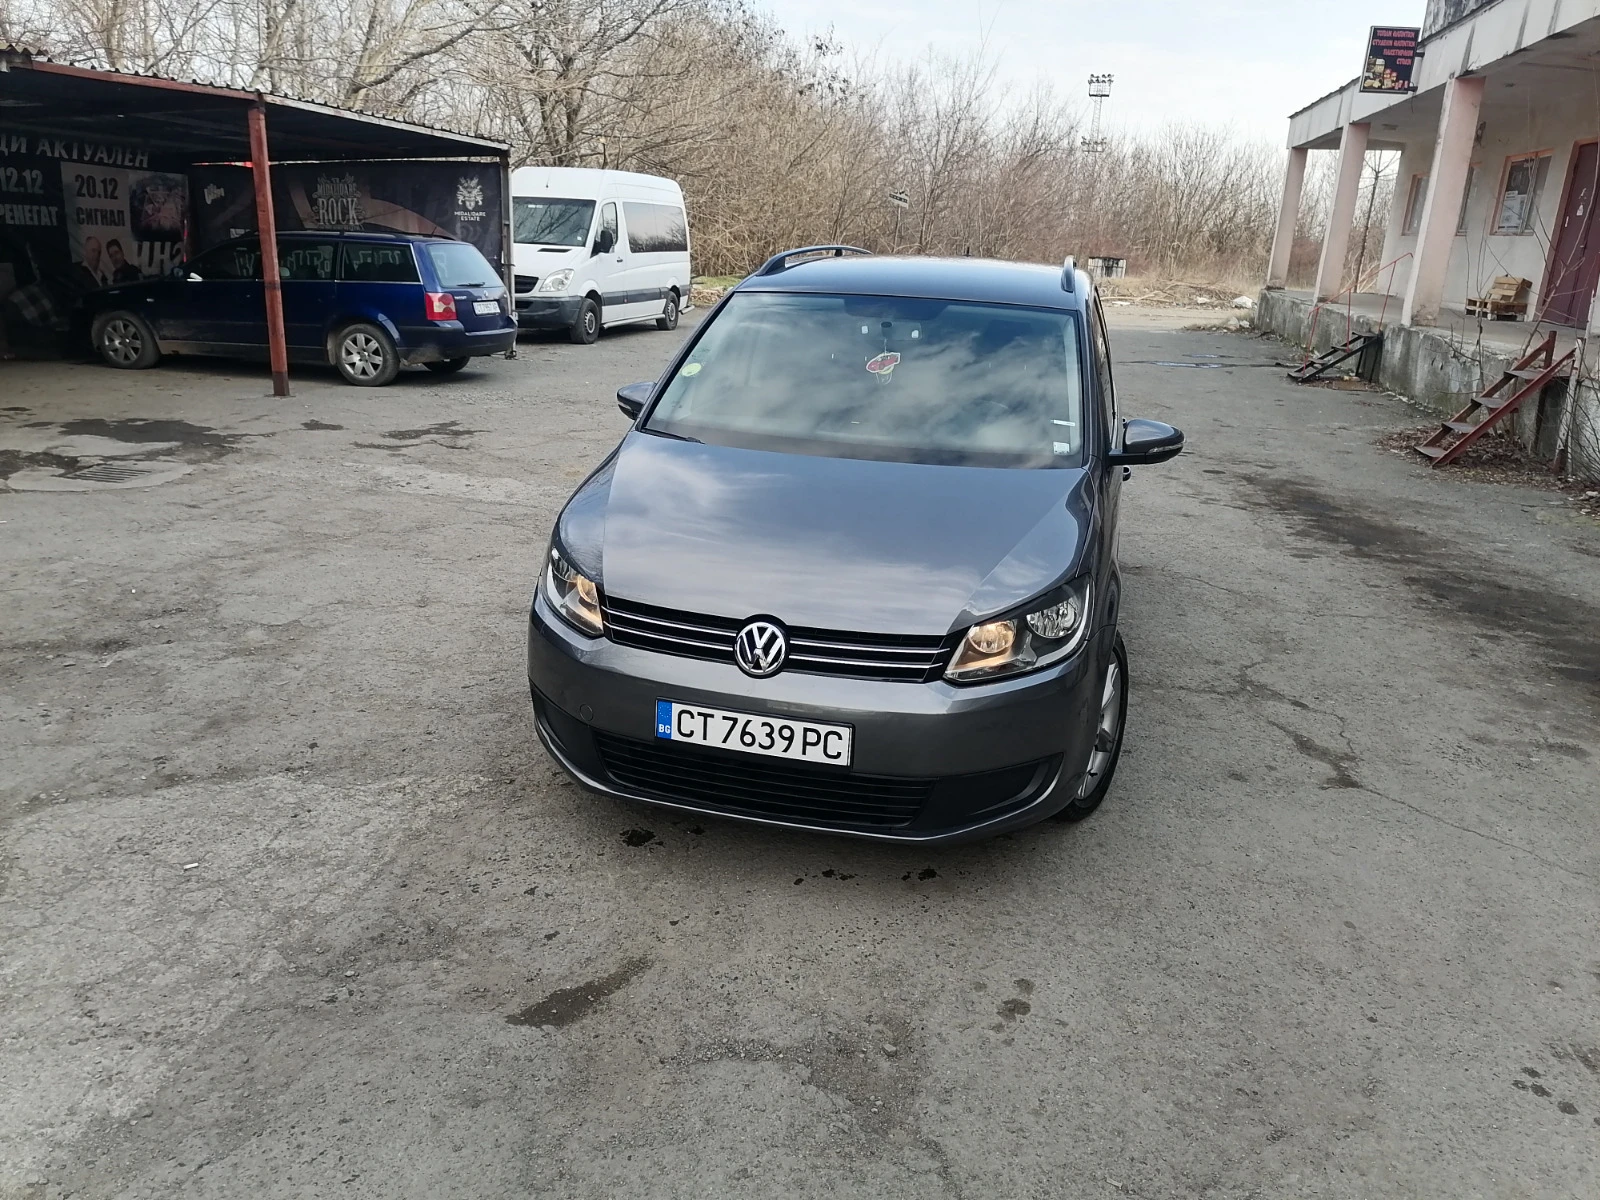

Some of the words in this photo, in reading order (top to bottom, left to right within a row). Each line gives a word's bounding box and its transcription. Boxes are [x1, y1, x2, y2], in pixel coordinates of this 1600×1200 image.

[36, 137, 149, 168] АКТУАЛЕН
[74, 174, 119, 200] 20.12
[75, 206, 126, 227] СИГНАЛ
[318, 197, 359, 225] ROCK
[658, 724, 671, 734] BG
[676, 709, 714, 741] CT
[721, 715, 795, 753] 7639
[802, 726, 843, 760] PC
